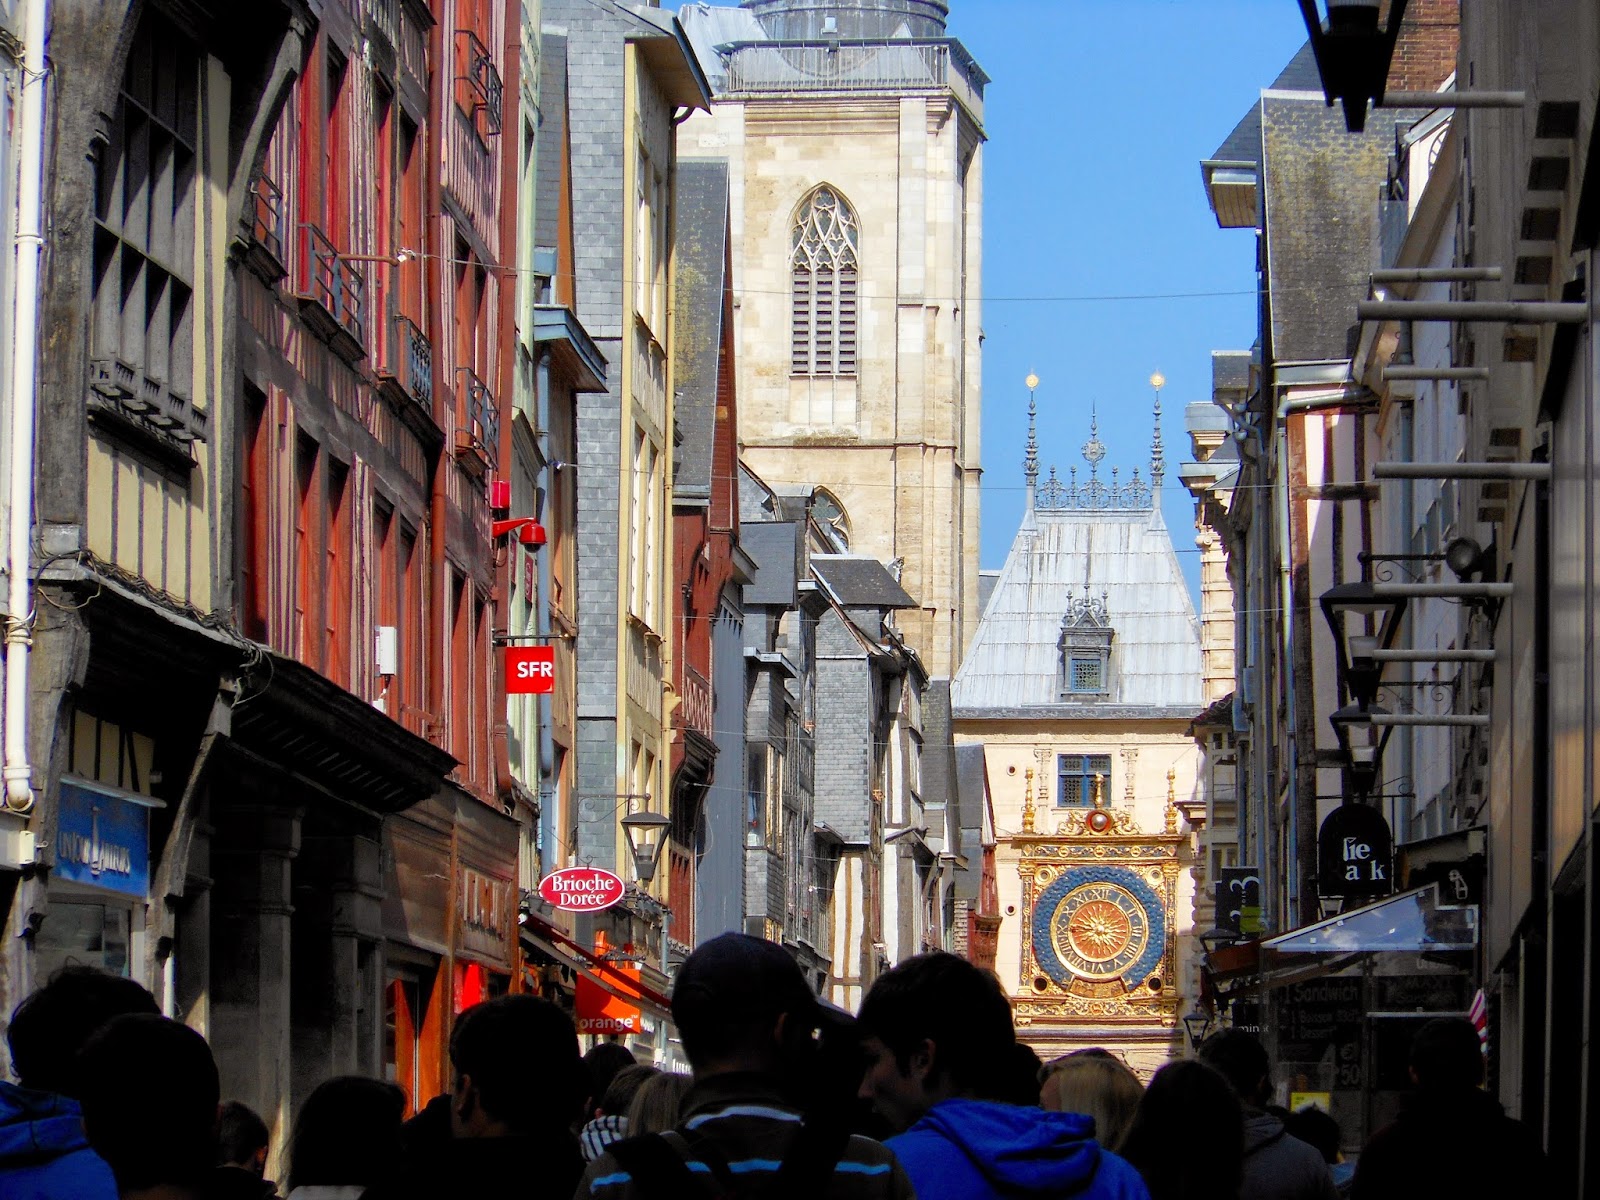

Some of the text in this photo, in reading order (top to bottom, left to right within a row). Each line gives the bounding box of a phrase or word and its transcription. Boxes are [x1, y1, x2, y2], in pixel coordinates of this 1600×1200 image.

[517, 661, 553, 678] SFR
[552, 873, 615, 892] Brioche
[560, 890, 606, 906] Dorée
[1293, 980, 1358, 1003] Sandwich
